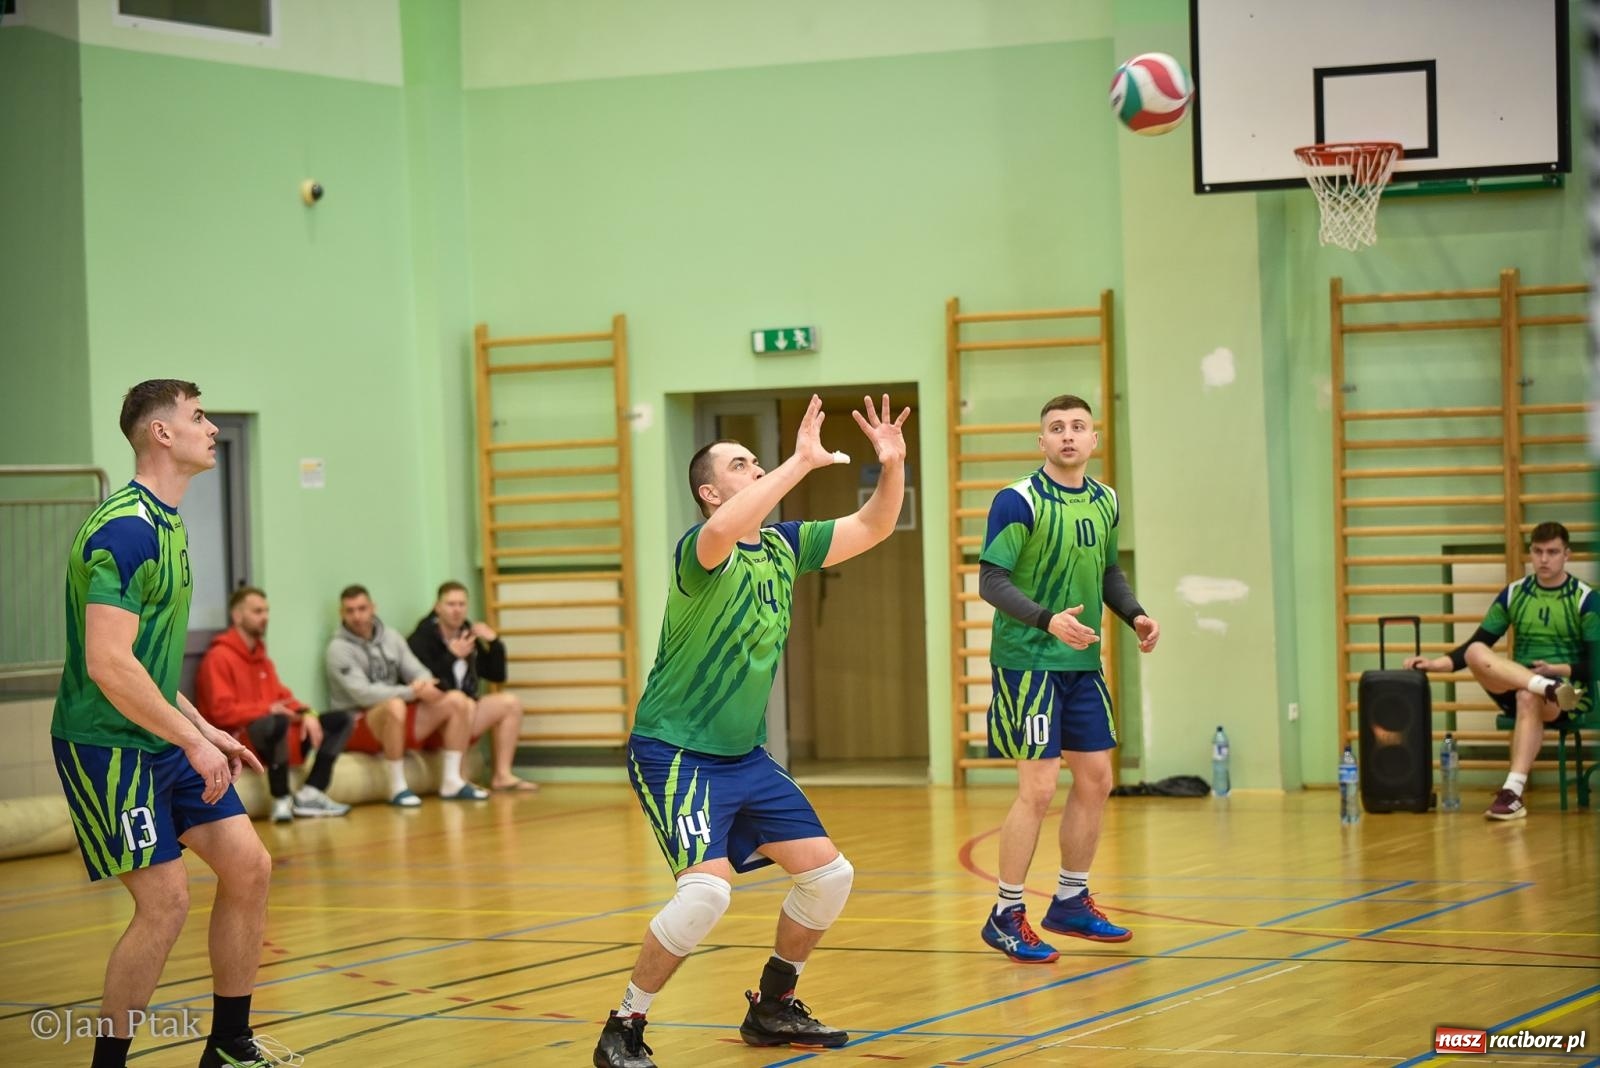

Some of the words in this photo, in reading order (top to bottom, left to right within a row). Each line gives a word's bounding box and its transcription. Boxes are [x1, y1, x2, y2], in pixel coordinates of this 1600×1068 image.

[1075, 518, 1096, 547] 10
[757, 579, 779, 613] 14
[1539, 606, 1550, 627] 4
[1025, 713, 1049, 746] 10
[121, 806, 157, 851] 13
[677, 810, 711, 849] 14
